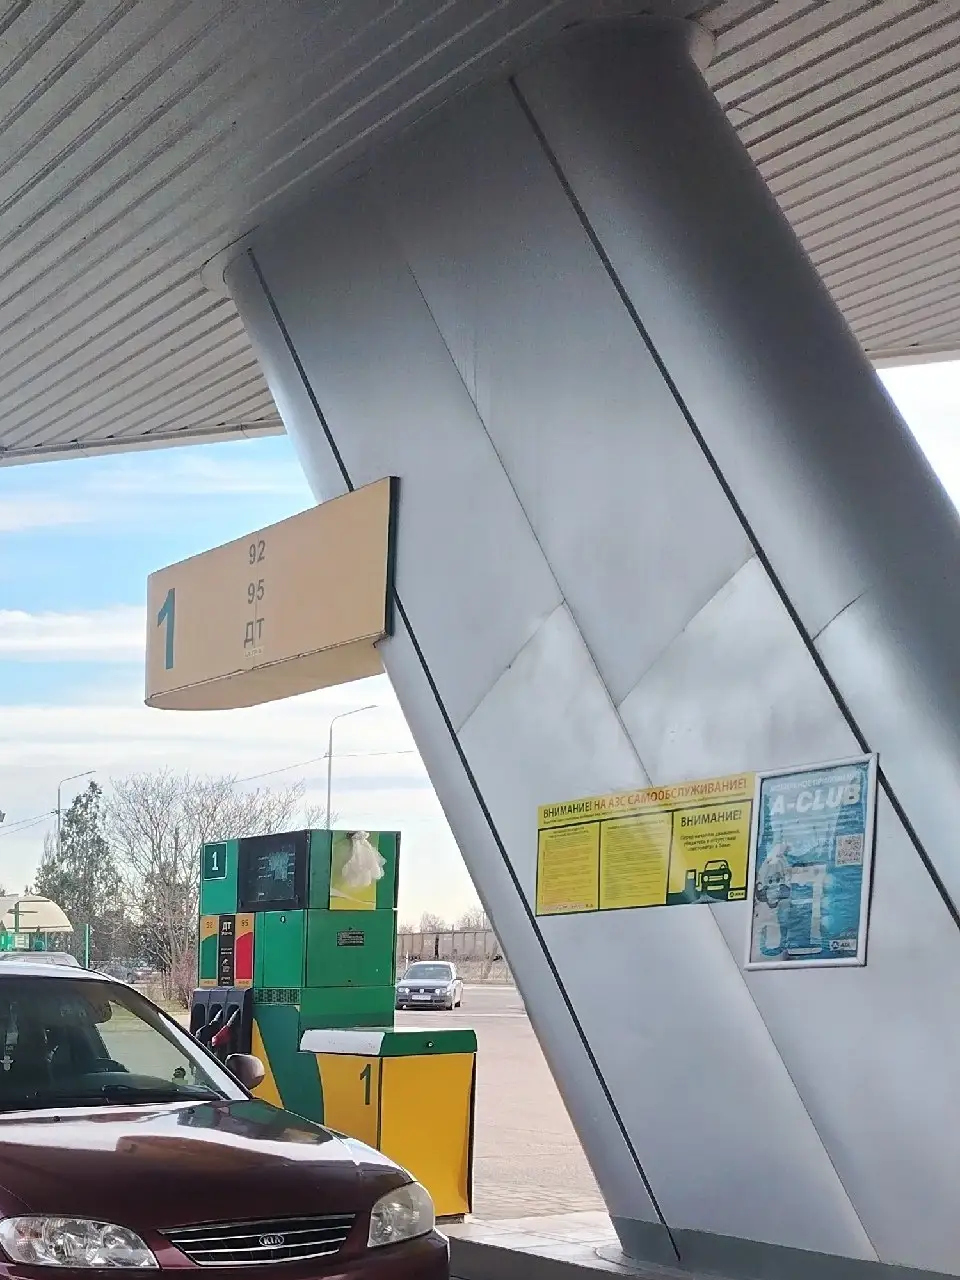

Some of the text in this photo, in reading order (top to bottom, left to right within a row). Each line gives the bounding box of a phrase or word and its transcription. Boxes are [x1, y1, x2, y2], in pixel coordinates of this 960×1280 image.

[248, 540, 266, 565] 92
[247, 579, 265, 604] 95
[157, 588, 176, 670] 1
[243, 618, 265, 648] ДТ
[543, 801, 592, 818] ВНИМАНИЕ!
[594, 800, 606, 811] НА
[608, 796, 626, 808] АЗС
[627, 778, 747, 804] САМООБСЛУЖИВАНИЕ!
[681, 810, 742, 827] ВНИМАНИЕ!
[212, 851, 219, 871] 1
[359, 1063, 371, 1106] 1
[263, 1235, 281, 1245] KIA
